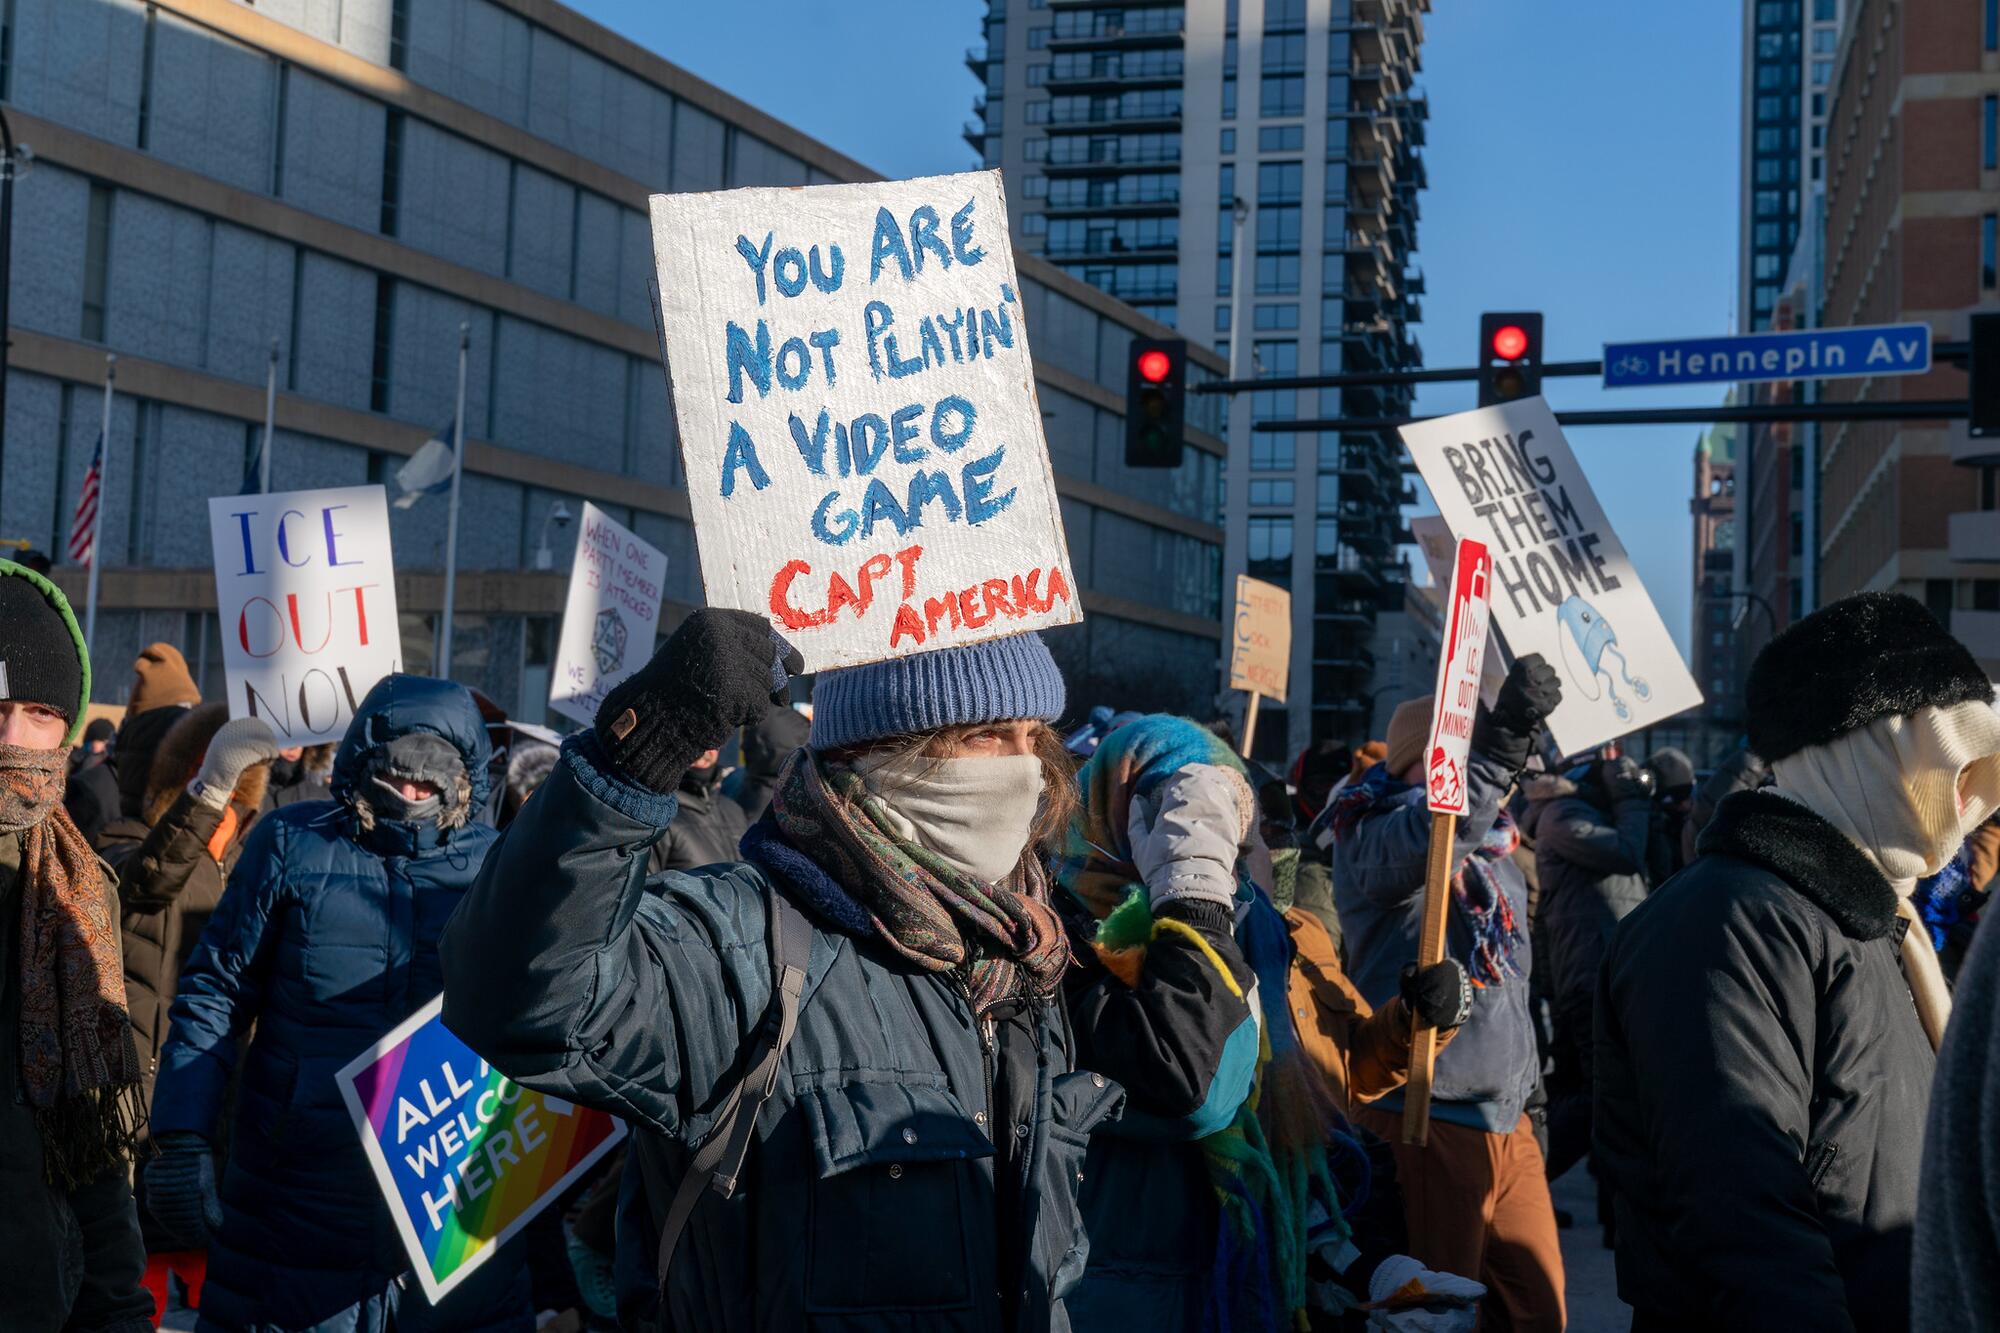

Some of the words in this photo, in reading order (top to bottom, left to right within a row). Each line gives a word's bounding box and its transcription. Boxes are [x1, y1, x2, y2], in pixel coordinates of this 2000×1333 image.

[734, 230, 845, 306] YOU
[870, 196, 988, 286] ARE
[725, 318, 840, 404] NOT
[863, 283, 1017, 384] PLAYIN'
[1658, 341, 1845, 376] Hennepin
[1866, 336, 1919, 364] Av
[720, 419, 772, 499] A
[788, 394, 978, 479] VIDEO
[1442, 430, 1556, 505] BRING
[810, 444, 1018, 546] GAME
[1474, 485, 1585, 553] THEM
[230, 505, 364, 576] ICE
[585, 517, 621, 553] WHEN
[625, 541, 650, 571] ONE
[1495, 532, 1622, 618] HOME
[238, 584, 380, 659] OUT
[586, 569, 601, 592] IS
[605, 581, 653, 621] ATTACKED
[768, 544, 924, 633] CAPT
[890, 566, 1070, 649] AMERICA
[398, 1061, 473, 1144] ALL
[405, 1077, 524, 1179] WELCO
[421, 1104, 547, 1231] HERE
